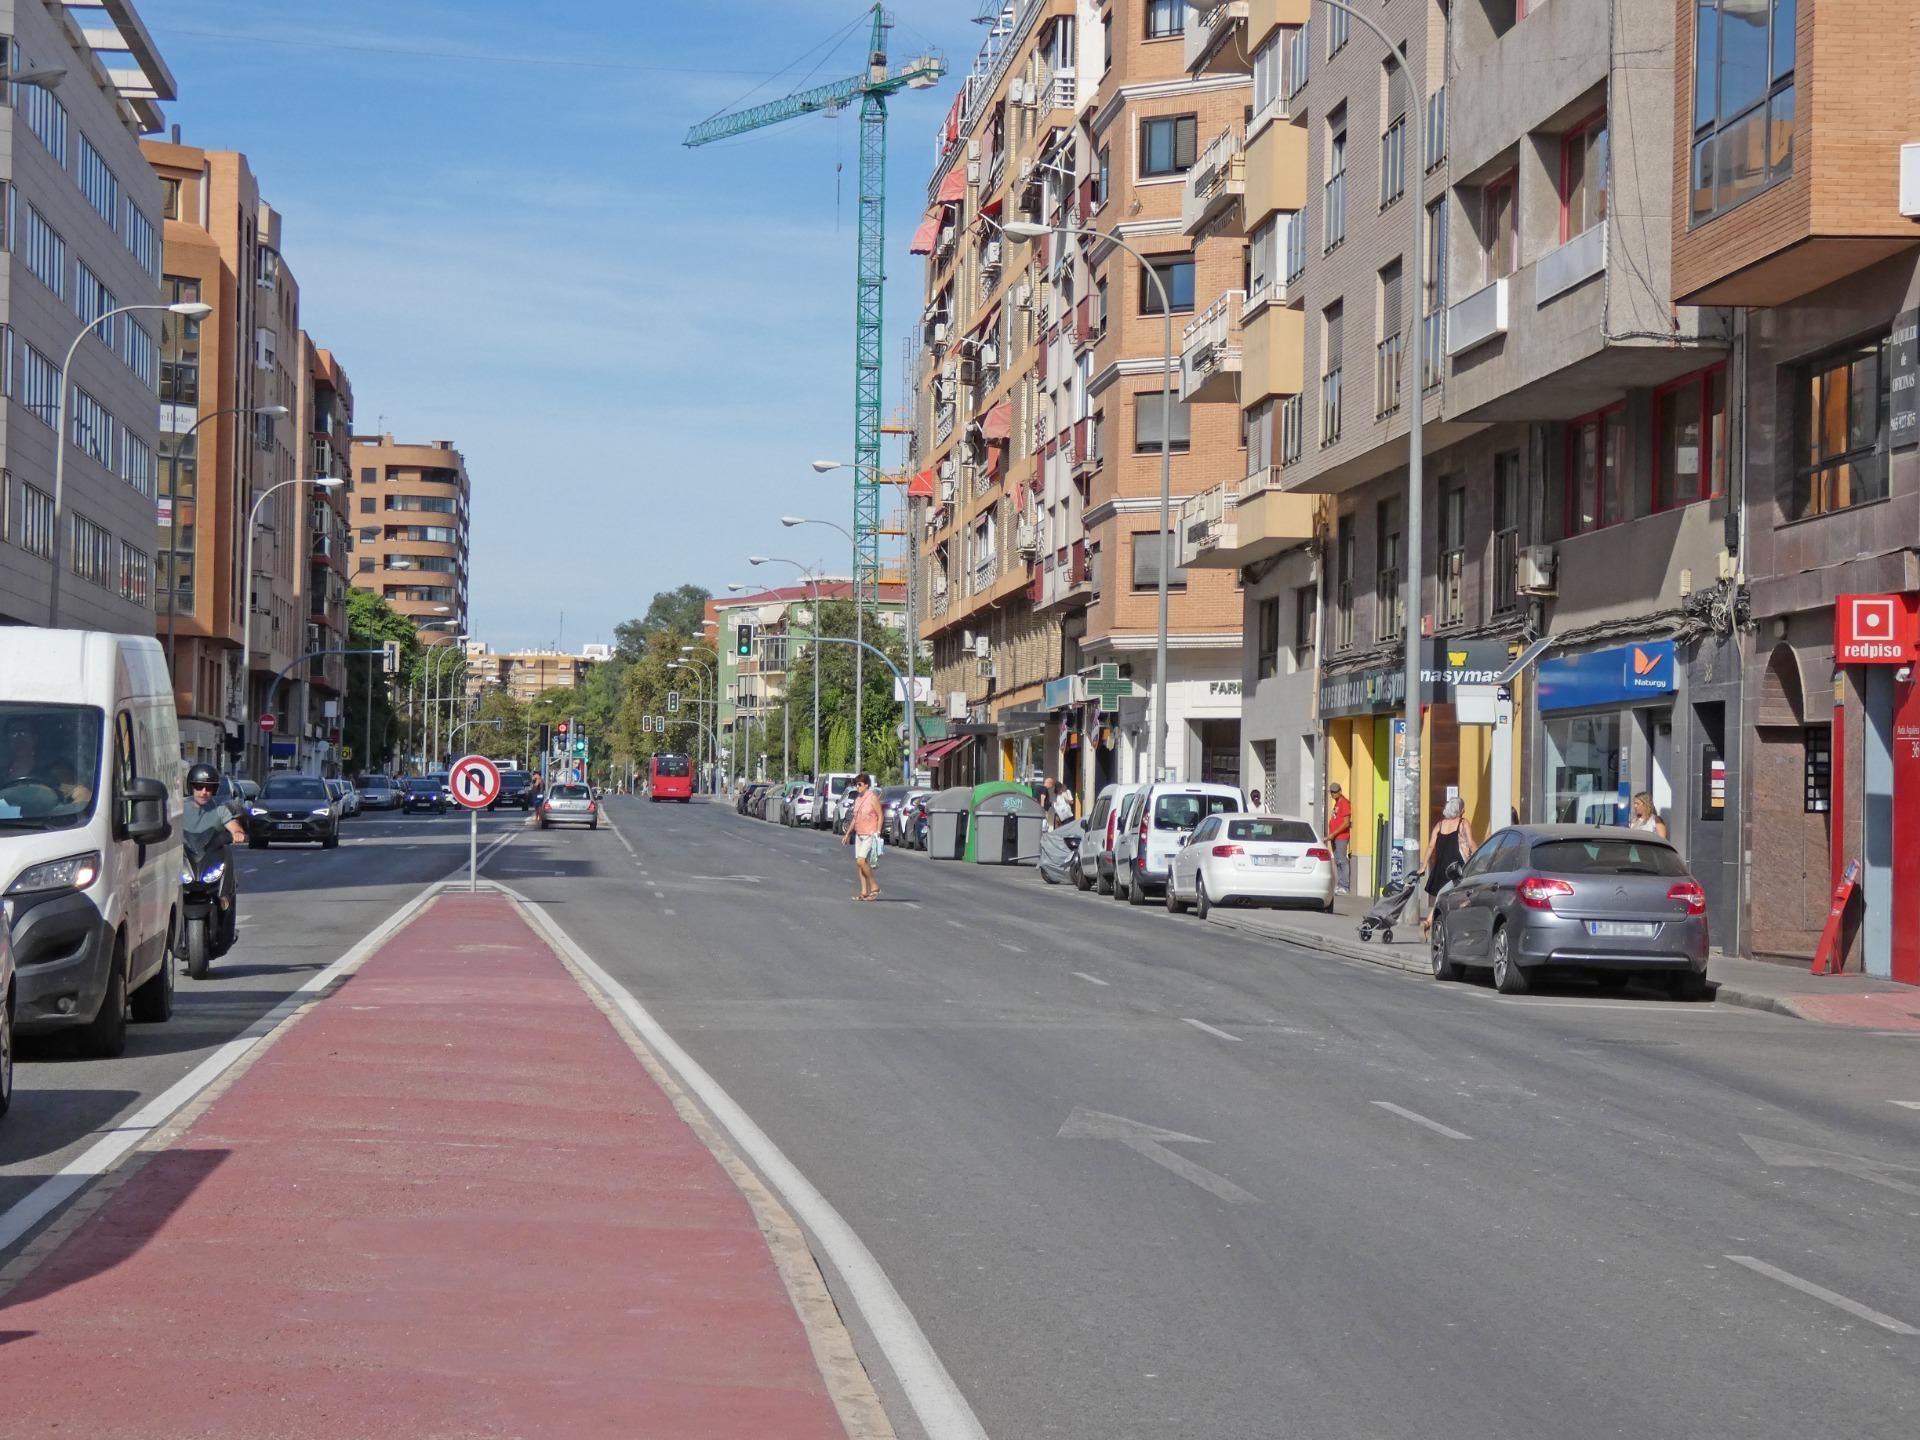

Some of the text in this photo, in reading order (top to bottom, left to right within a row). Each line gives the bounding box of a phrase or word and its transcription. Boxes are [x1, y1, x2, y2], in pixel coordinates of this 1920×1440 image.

[1893, 373, 1915, 392] OFICINAS
[1844, 642, 1902, 659] redpiso
[1634, 678, 1666, 688] Naturgy
[1320, 681, 1364, 710] SUPERMERCADO
